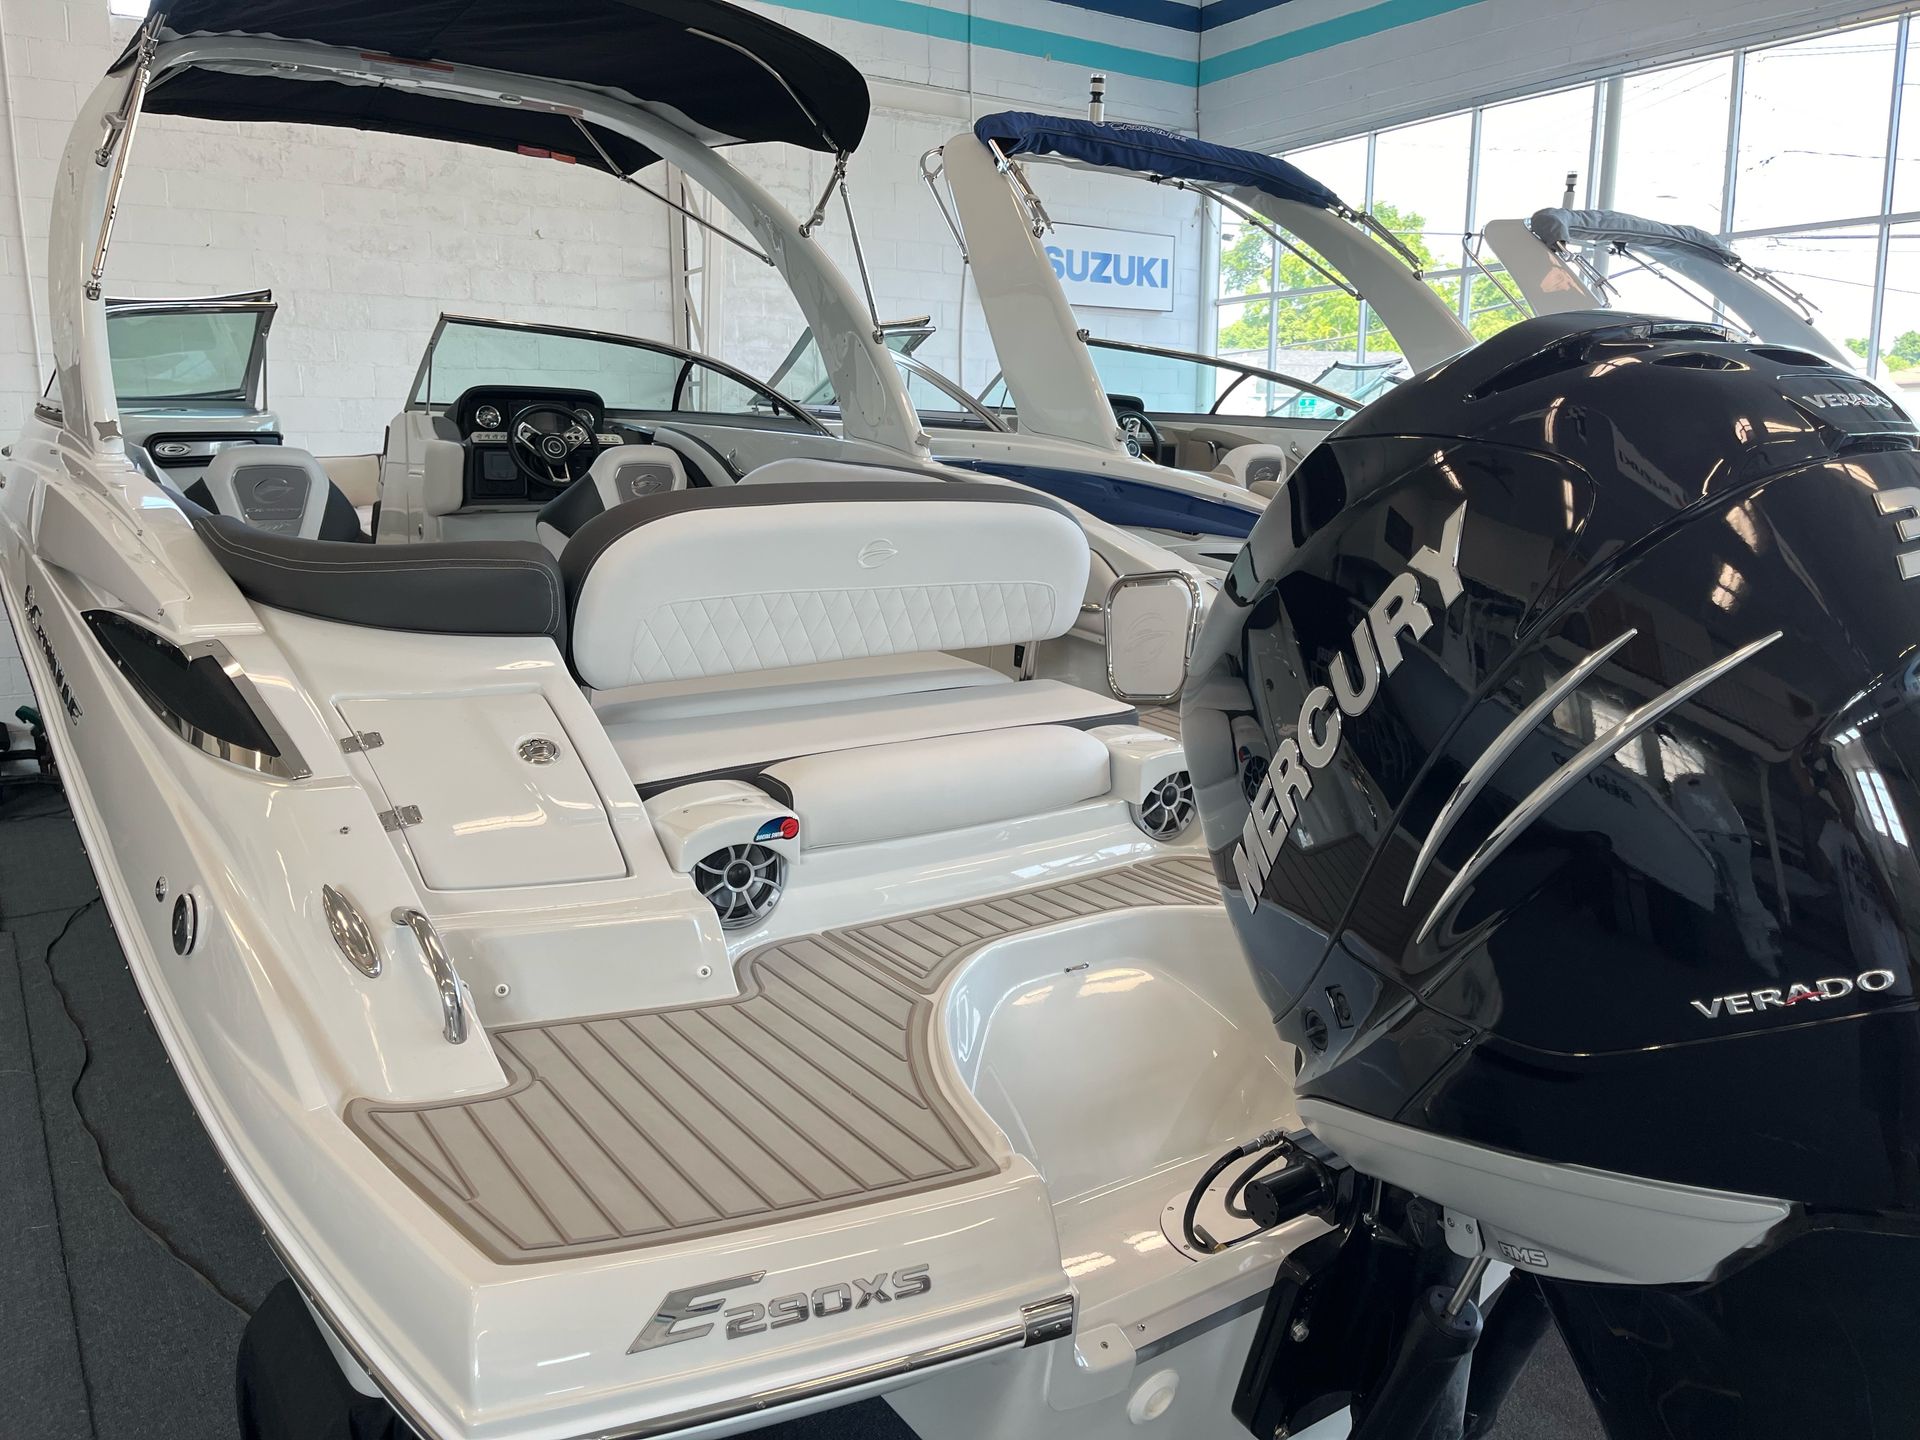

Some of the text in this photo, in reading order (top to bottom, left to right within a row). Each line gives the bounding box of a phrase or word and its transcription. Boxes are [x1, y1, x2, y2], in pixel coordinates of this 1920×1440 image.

[1043, 245, 1169, 289] SUZUKI
[1802, 393, 1893, 409] VERADO
[1232, 499, 1465, 915] MERCURY
[1690, 969, 1896, 1019] VERADO
